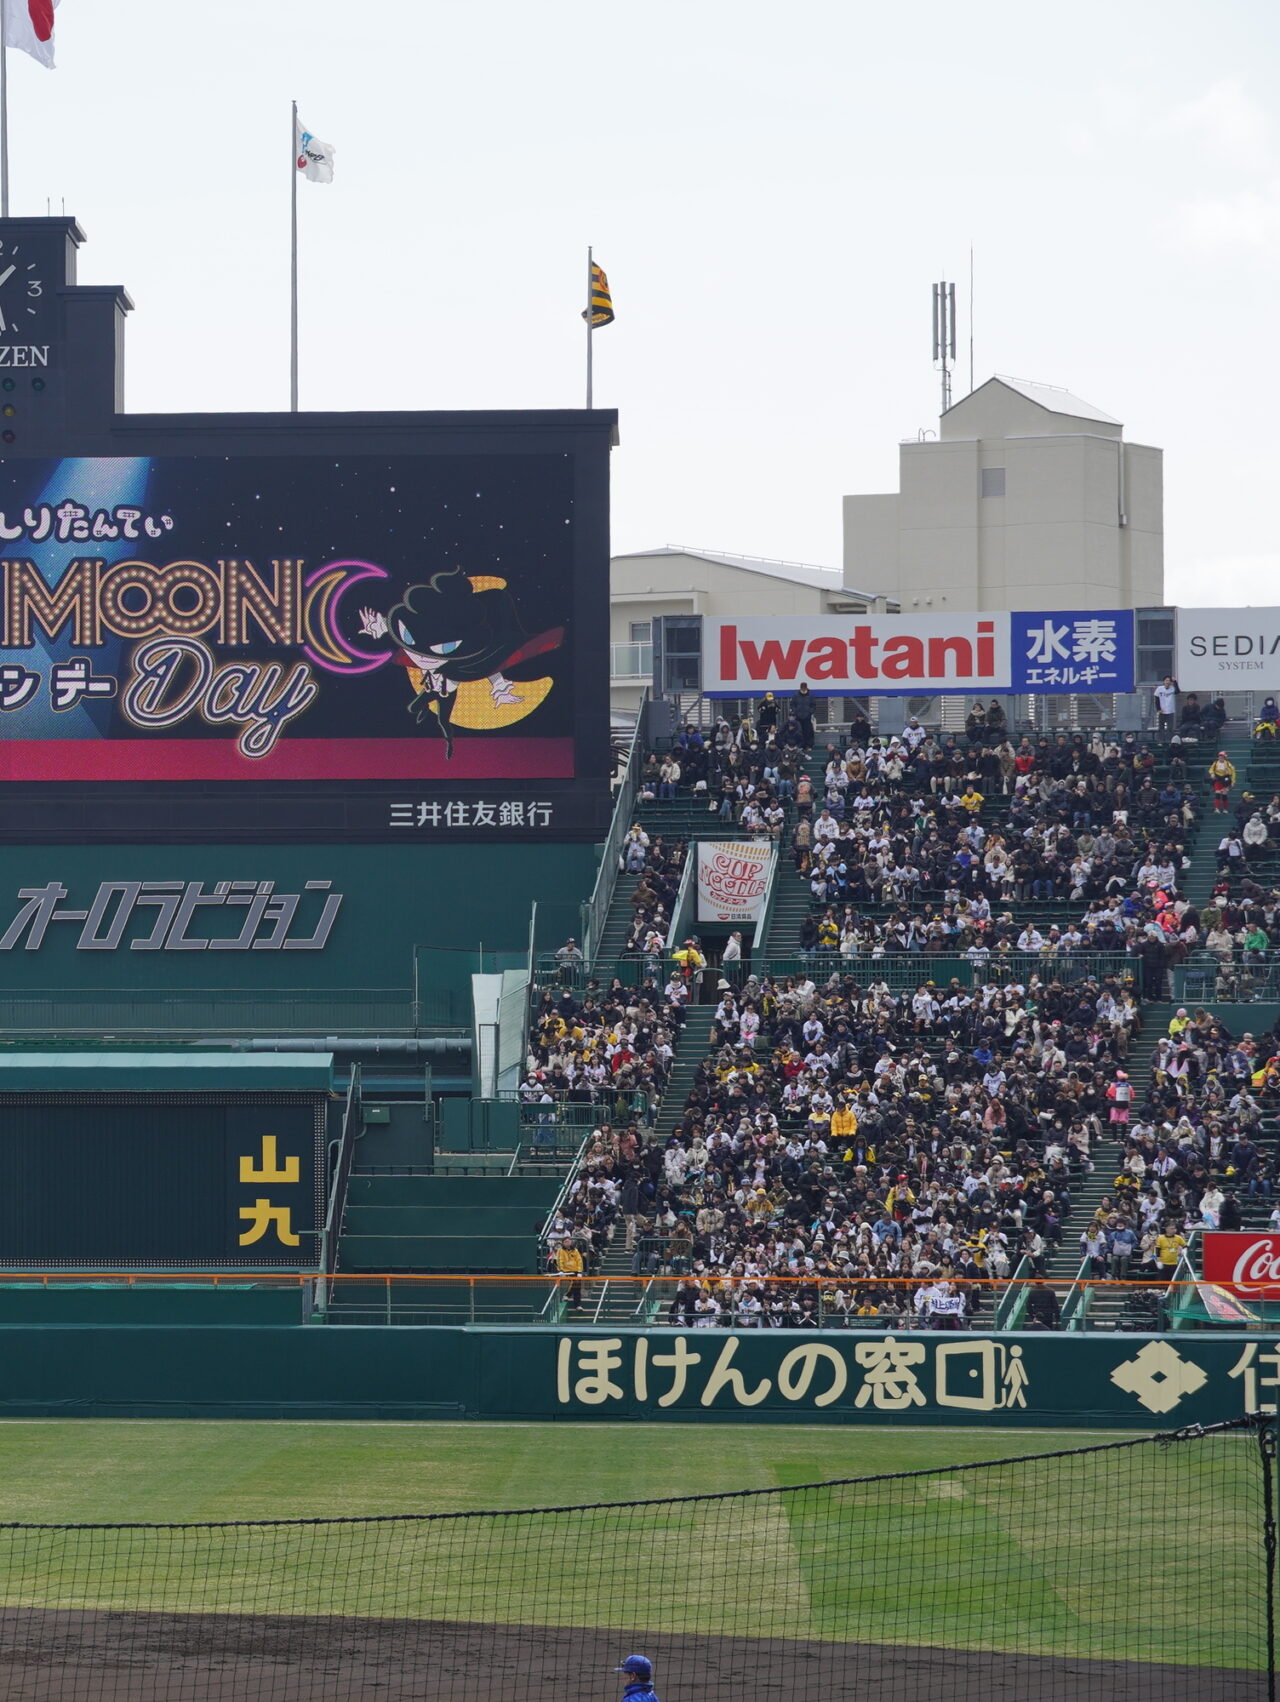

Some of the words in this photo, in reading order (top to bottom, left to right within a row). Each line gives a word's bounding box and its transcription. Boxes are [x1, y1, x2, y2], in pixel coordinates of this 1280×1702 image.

[27, 281, 42, 297] 3
[1, 560, 305, 645] MOON
[720, 621, 995, 681] Iwatani
[1026, 619, 1117, 663] 水素
[56, 663, 110, 705] デー
[1026, 665, 1117, 686] エネルギー
[1218, 661, 1264, 671] SYSTEM
[124, 635, 318, 758] Day
[389, 801, 553, 827] 三井住友銀行
[712, 852, 763, 880] CUP
[239, 1135, 300, 1247] 山九
[557, 1335, 1007, 1411] ほけんの窓口
